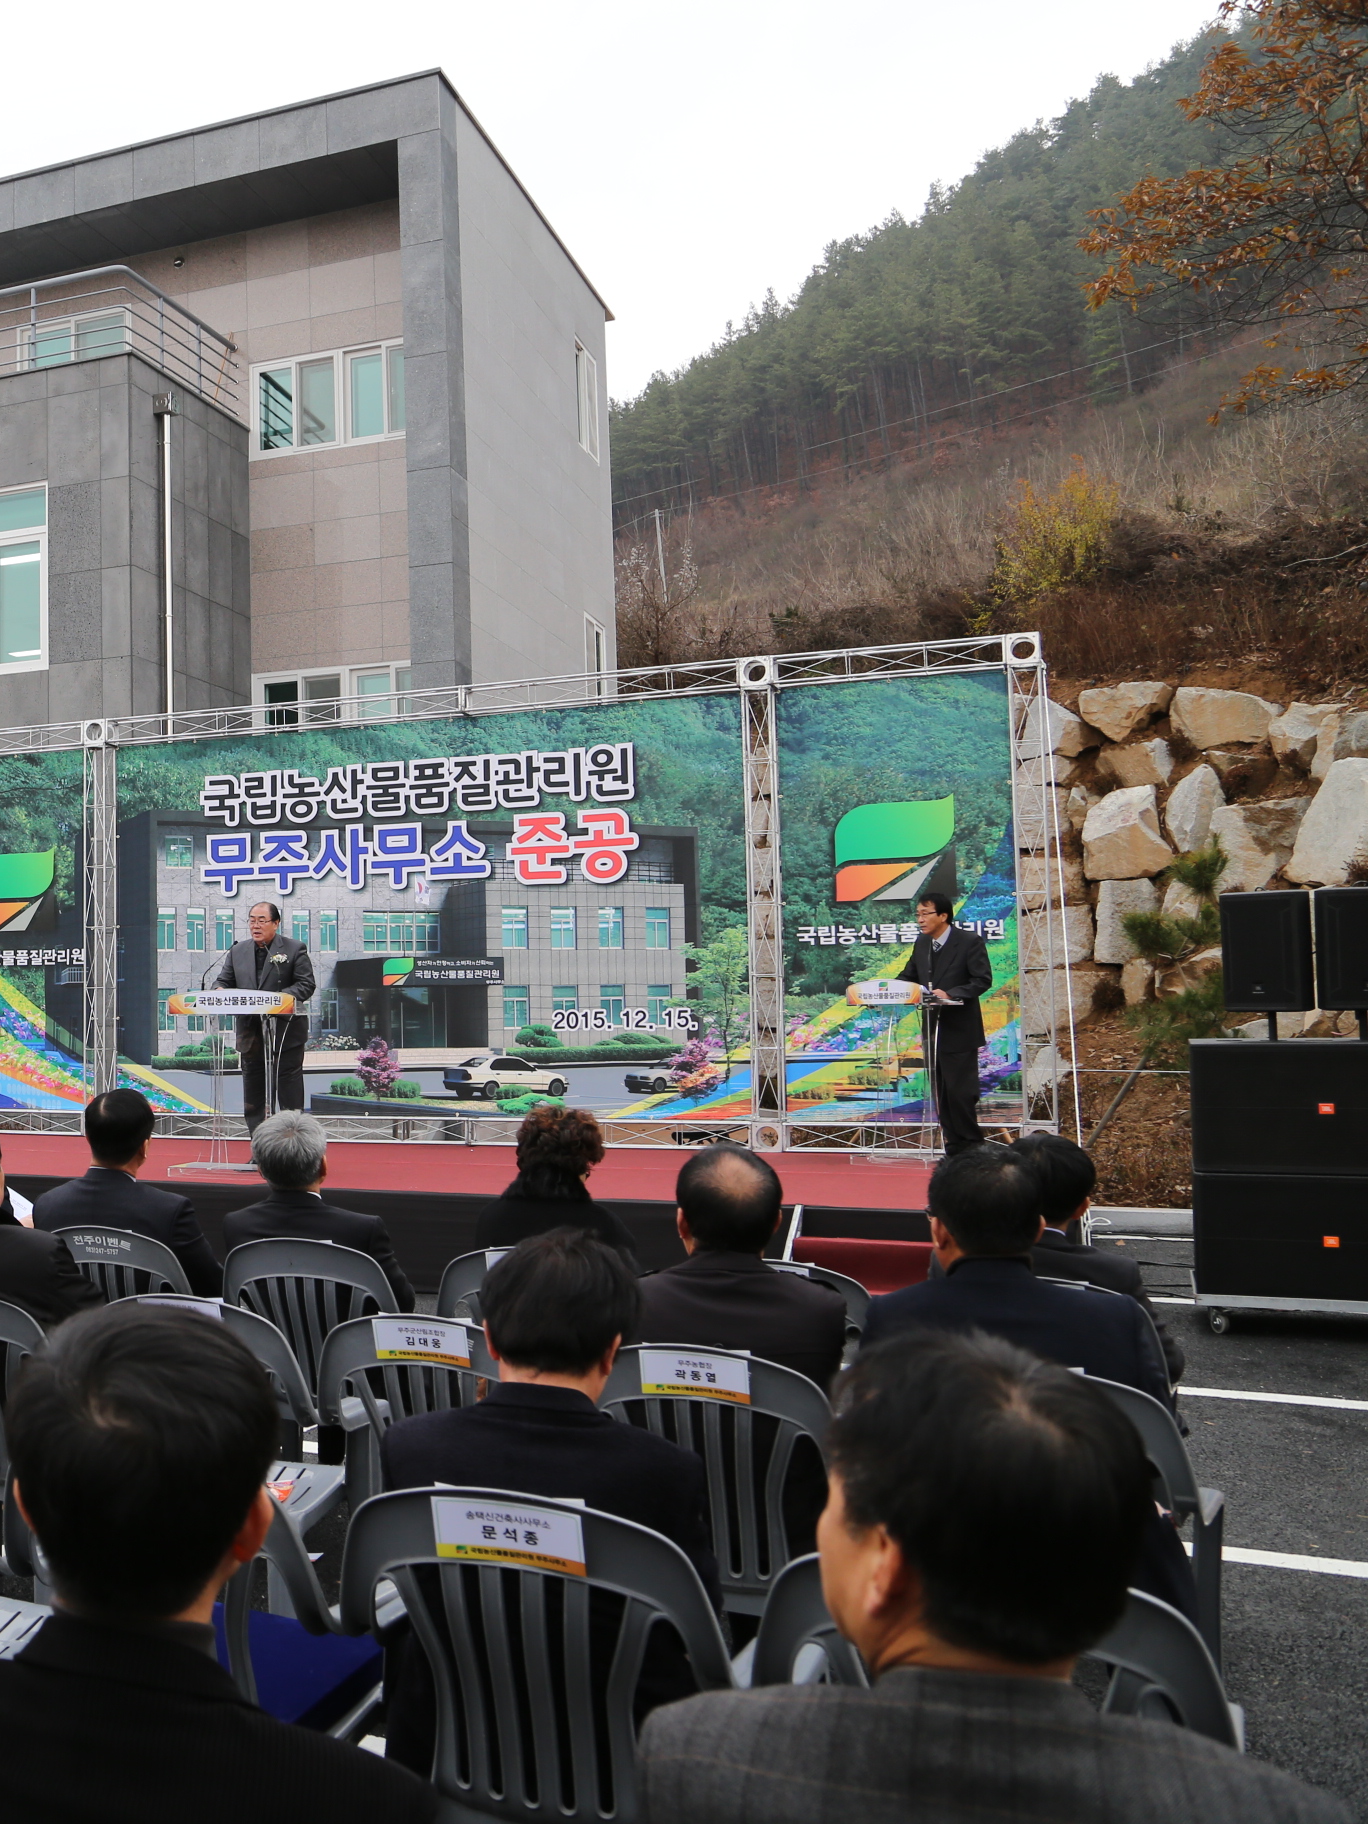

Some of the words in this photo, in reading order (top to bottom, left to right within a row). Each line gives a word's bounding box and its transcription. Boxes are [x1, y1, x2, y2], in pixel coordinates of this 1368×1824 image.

[202, 745, 633, 825] 국립농산물품질관리원
[201, 821, 491, 896] 무주사무소
[507, 808, 639, 885] 준공
[796, 919, 1006, 946] 국립농산물품리원
[415, 970, 500, 979] 국립농산물품질관리원
[198, 995, 281, 1007] 국립농산물품질관리원
[857, 991, 911, 1000] 국립농산물품질관리원
[552, 1008, 613, 1031] 2015.
[622, 1008, 655, 1030] 12.
[664, 1007, 699, 1030] 15.
[73, 1235, 131, 1251] 전주이벤트
